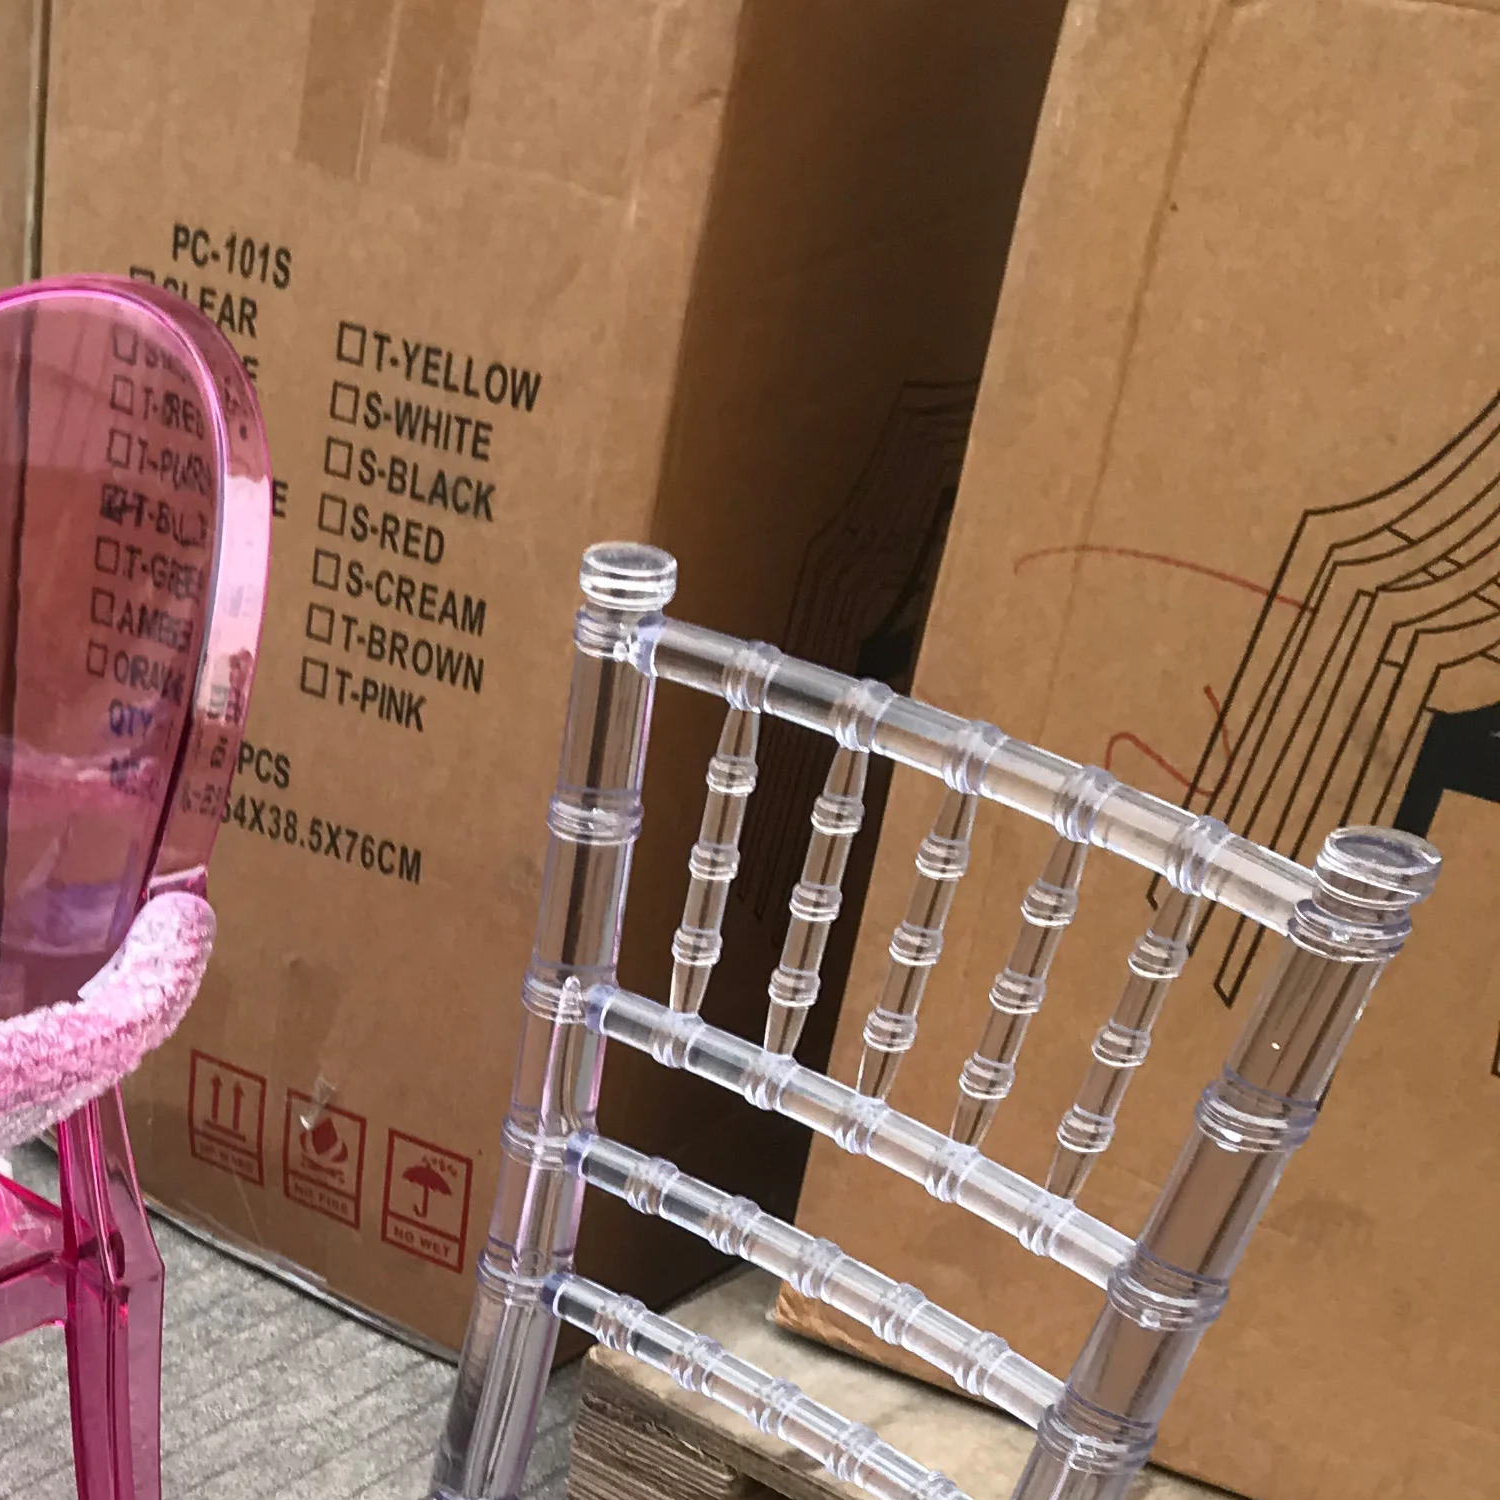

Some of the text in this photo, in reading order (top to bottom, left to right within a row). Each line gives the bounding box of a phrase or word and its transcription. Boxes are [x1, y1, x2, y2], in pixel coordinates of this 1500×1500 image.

[172, 222, 292, 291] PC-101S
[372, 331, 542, 413] T-YELLOW
[363, 391, 493, 462] S-WHITE
[358, 447, 496, 523] S-BLACK
[351, 504, 445, 566] S-RED
[346, 560, 487, 638] S-CREAM
[340, 614, 485, 694] T-BROWN
[335, 667, 428, 732] T-PINK
[238, 740, 291, 789] PCS
[394, 1225, 451, 1258] NO WET
